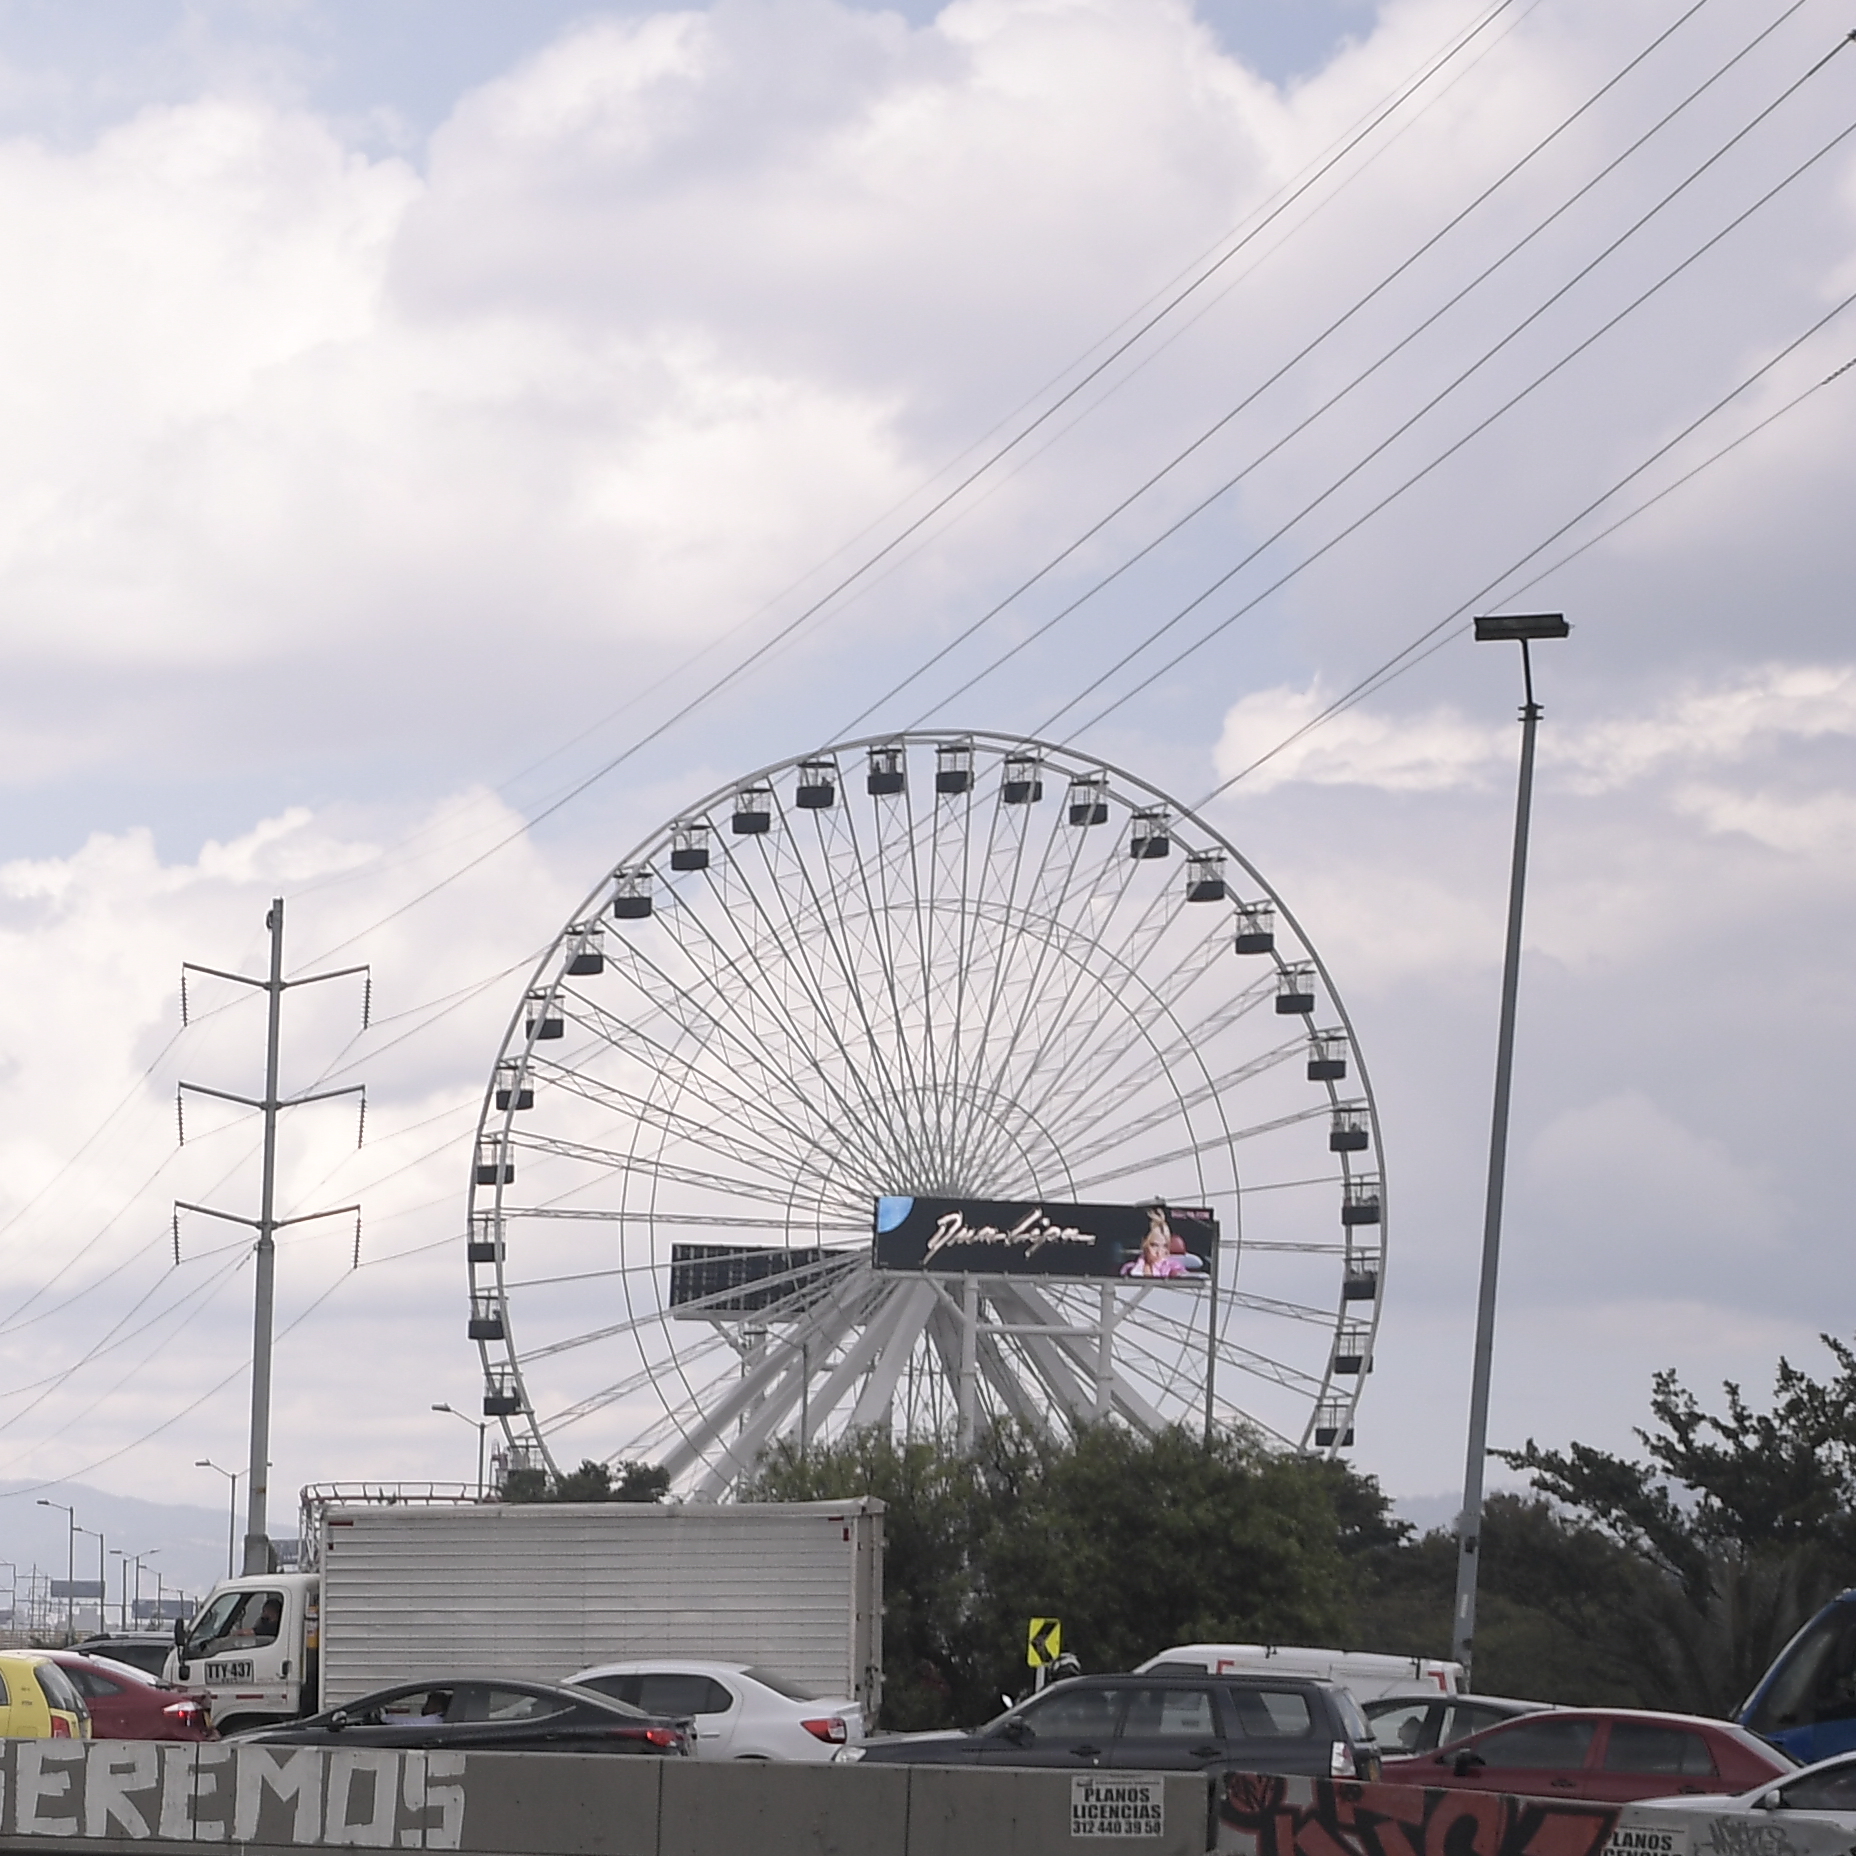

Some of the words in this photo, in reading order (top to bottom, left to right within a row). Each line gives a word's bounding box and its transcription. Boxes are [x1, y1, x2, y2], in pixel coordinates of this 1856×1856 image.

[1084, 1787, 1150, 1802] PLANOS
[1073, 1804, 1161, 1819] LICENCIAS
[1073, 1820, 1094, 1833] 312
[1098, 1820, 1121, 1833] 440
[1125, 1820, 1141, 1833] 39
[1612, 1831, 1673, 1851] LANOS
